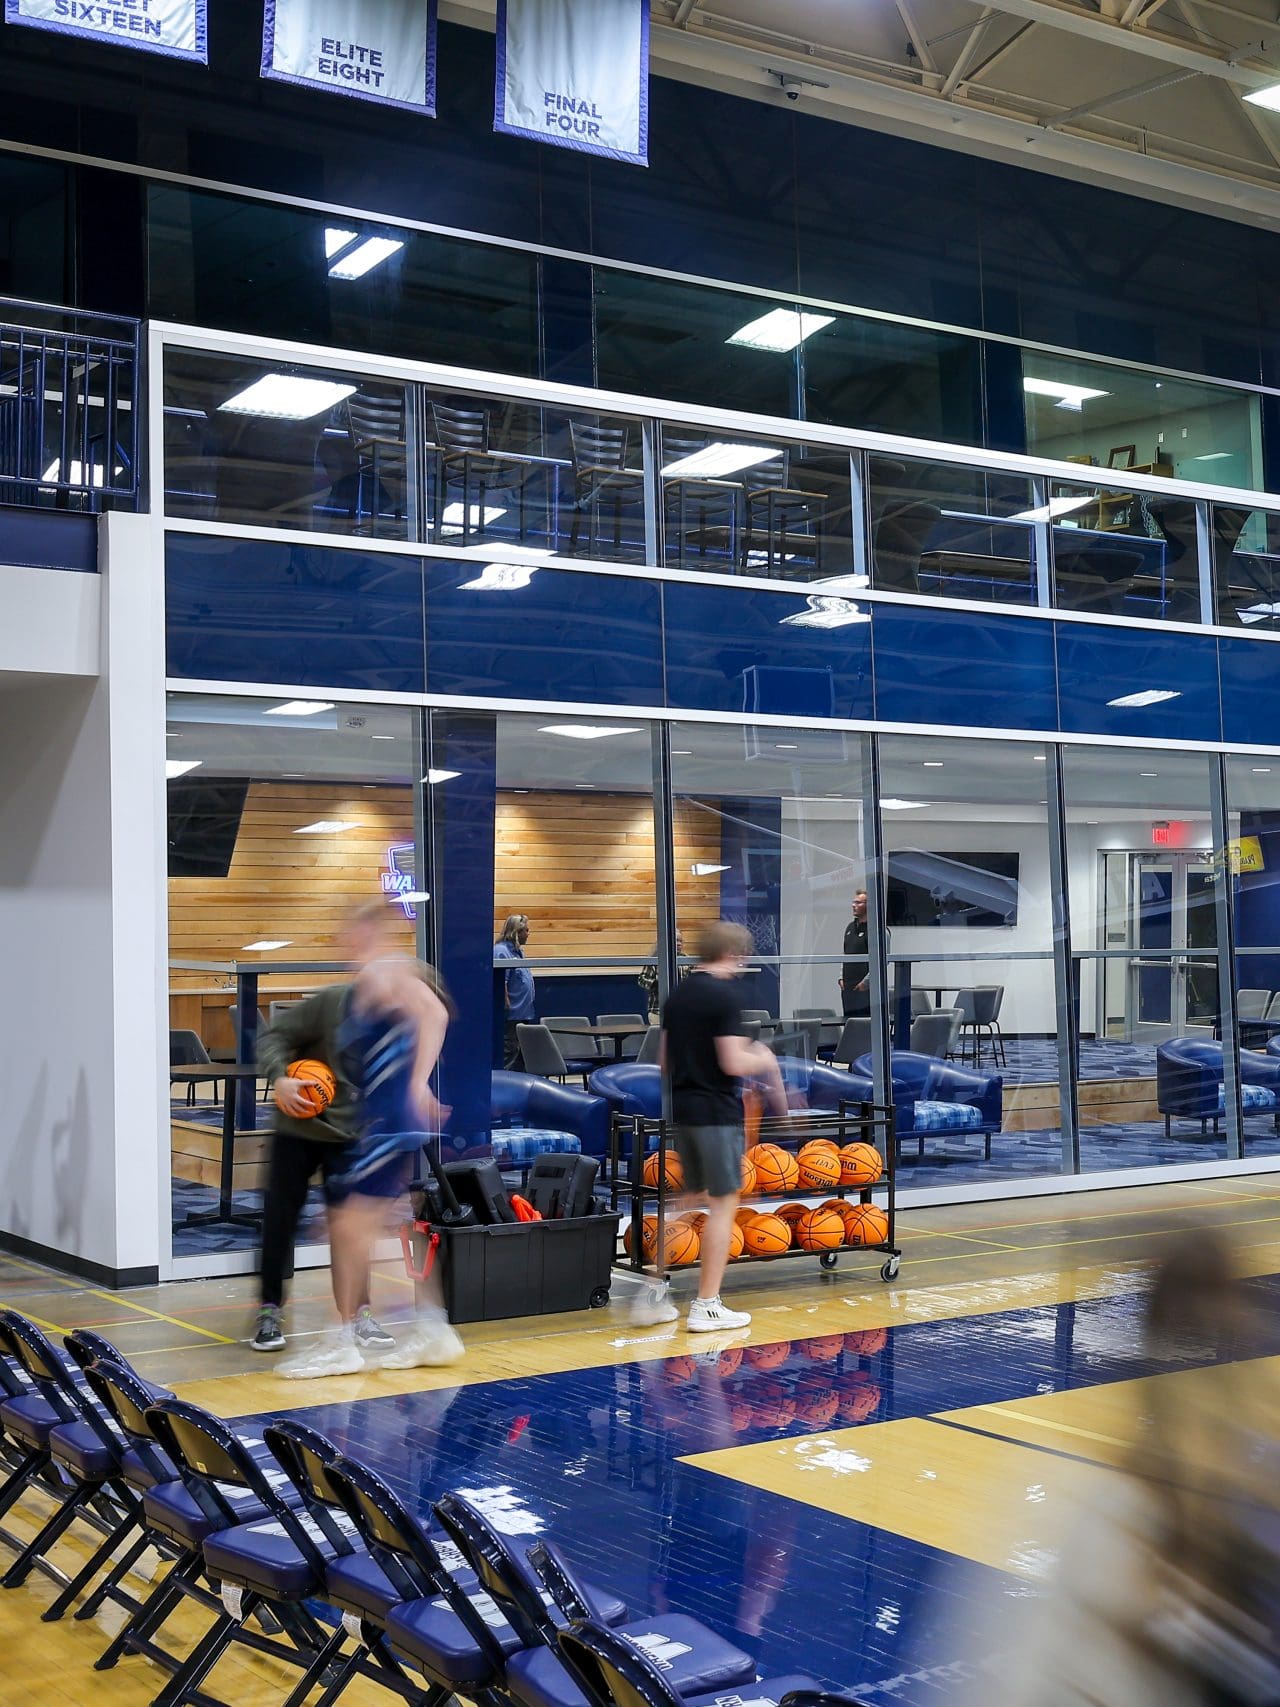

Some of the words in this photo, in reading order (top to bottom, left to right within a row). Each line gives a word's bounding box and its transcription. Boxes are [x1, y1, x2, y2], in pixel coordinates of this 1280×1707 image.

[54, 0, 162, 37] SIXTEEN
[321, 37, 383, 67] ELITE
[318, 57, 385, 87] EIGHT
[544, 92, 602, 119] FINAL
[546, 111, 600, 137] FOUR
[384, 875, 415, 890] WA
